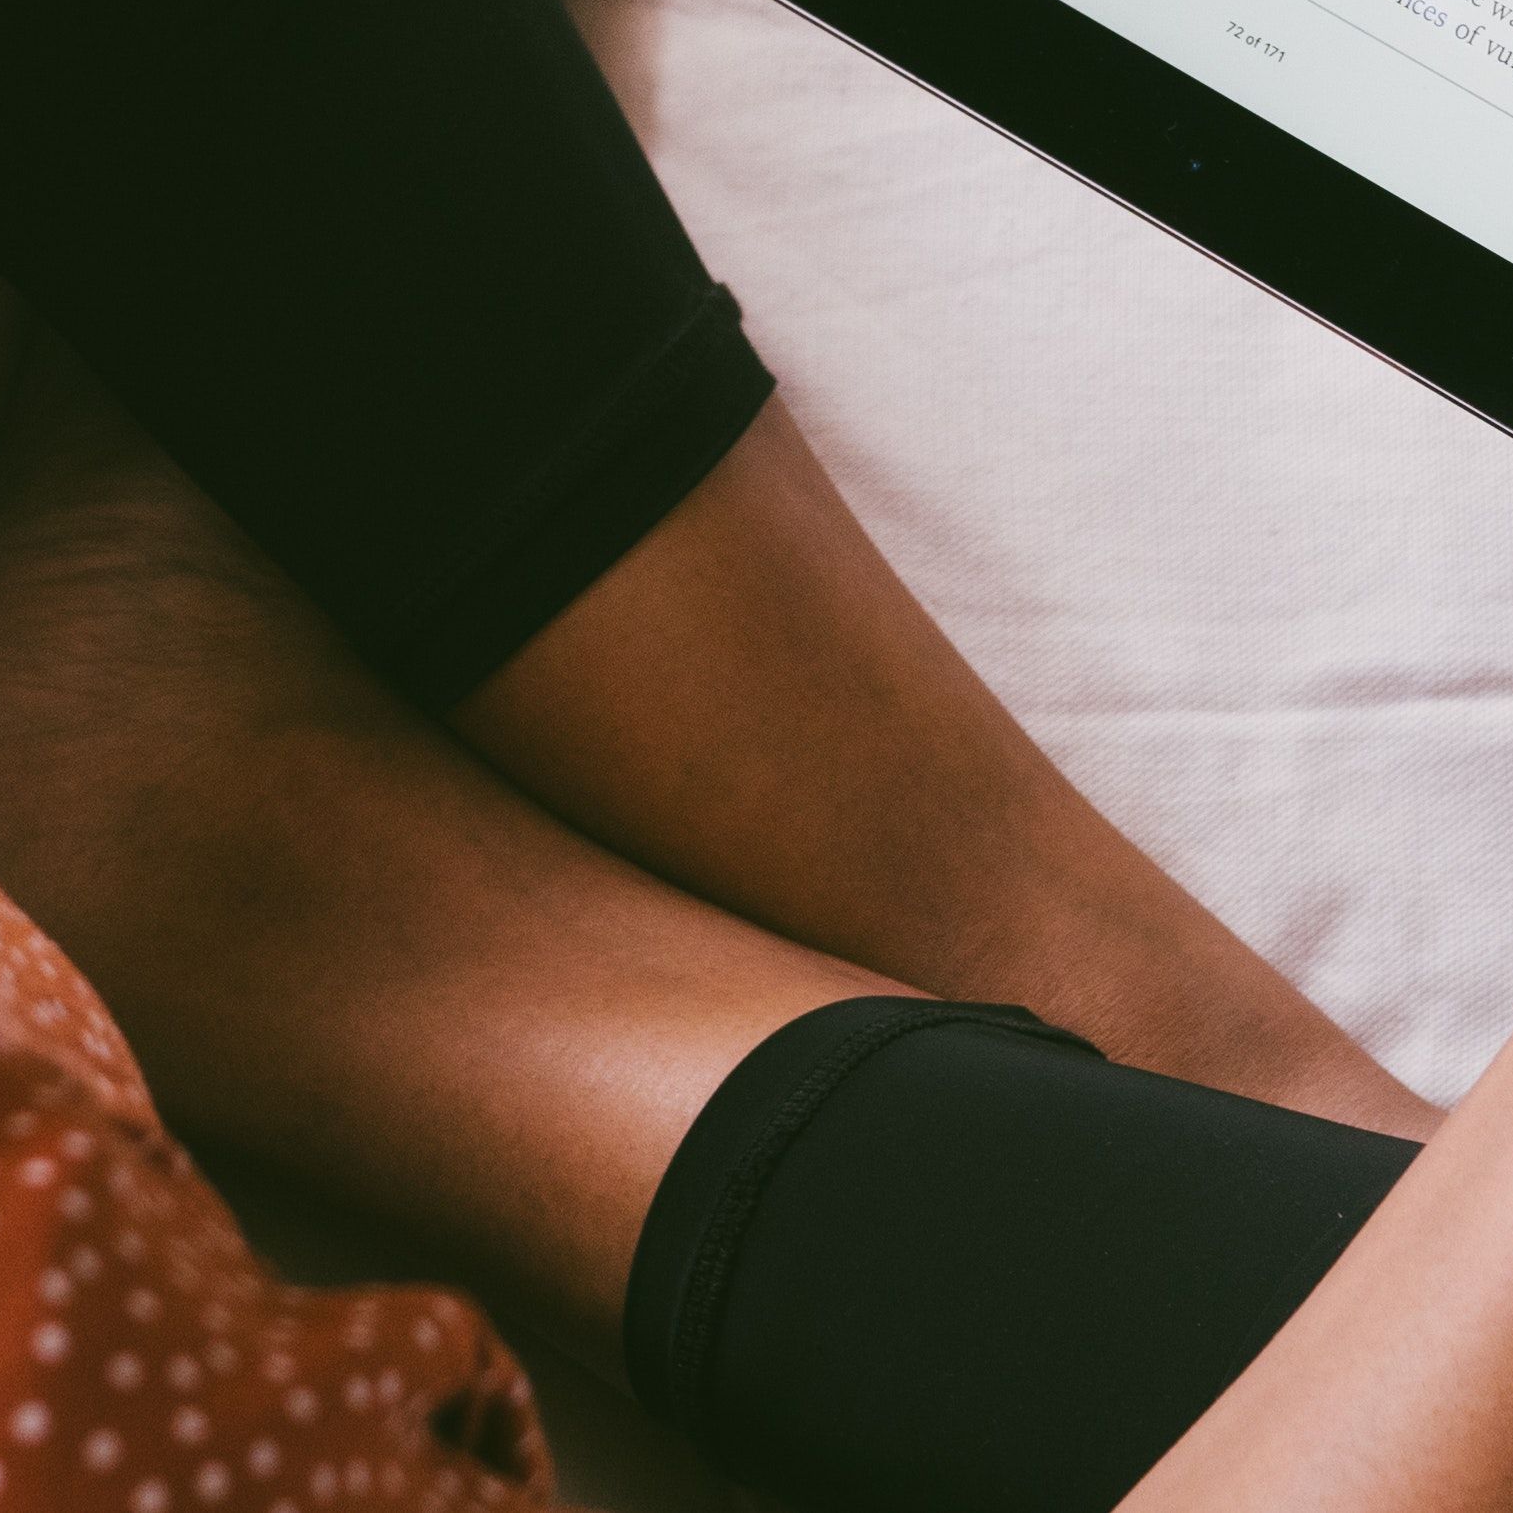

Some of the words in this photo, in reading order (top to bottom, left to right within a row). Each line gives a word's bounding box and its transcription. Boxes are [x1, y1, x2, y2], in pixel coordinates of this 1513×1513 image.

[1225, 20, 1245, 39] 72
[1245, 35, 1262, 48] of
[1263, 43, 1286, 63] 171
[1454, 23, 1487, 46] of
